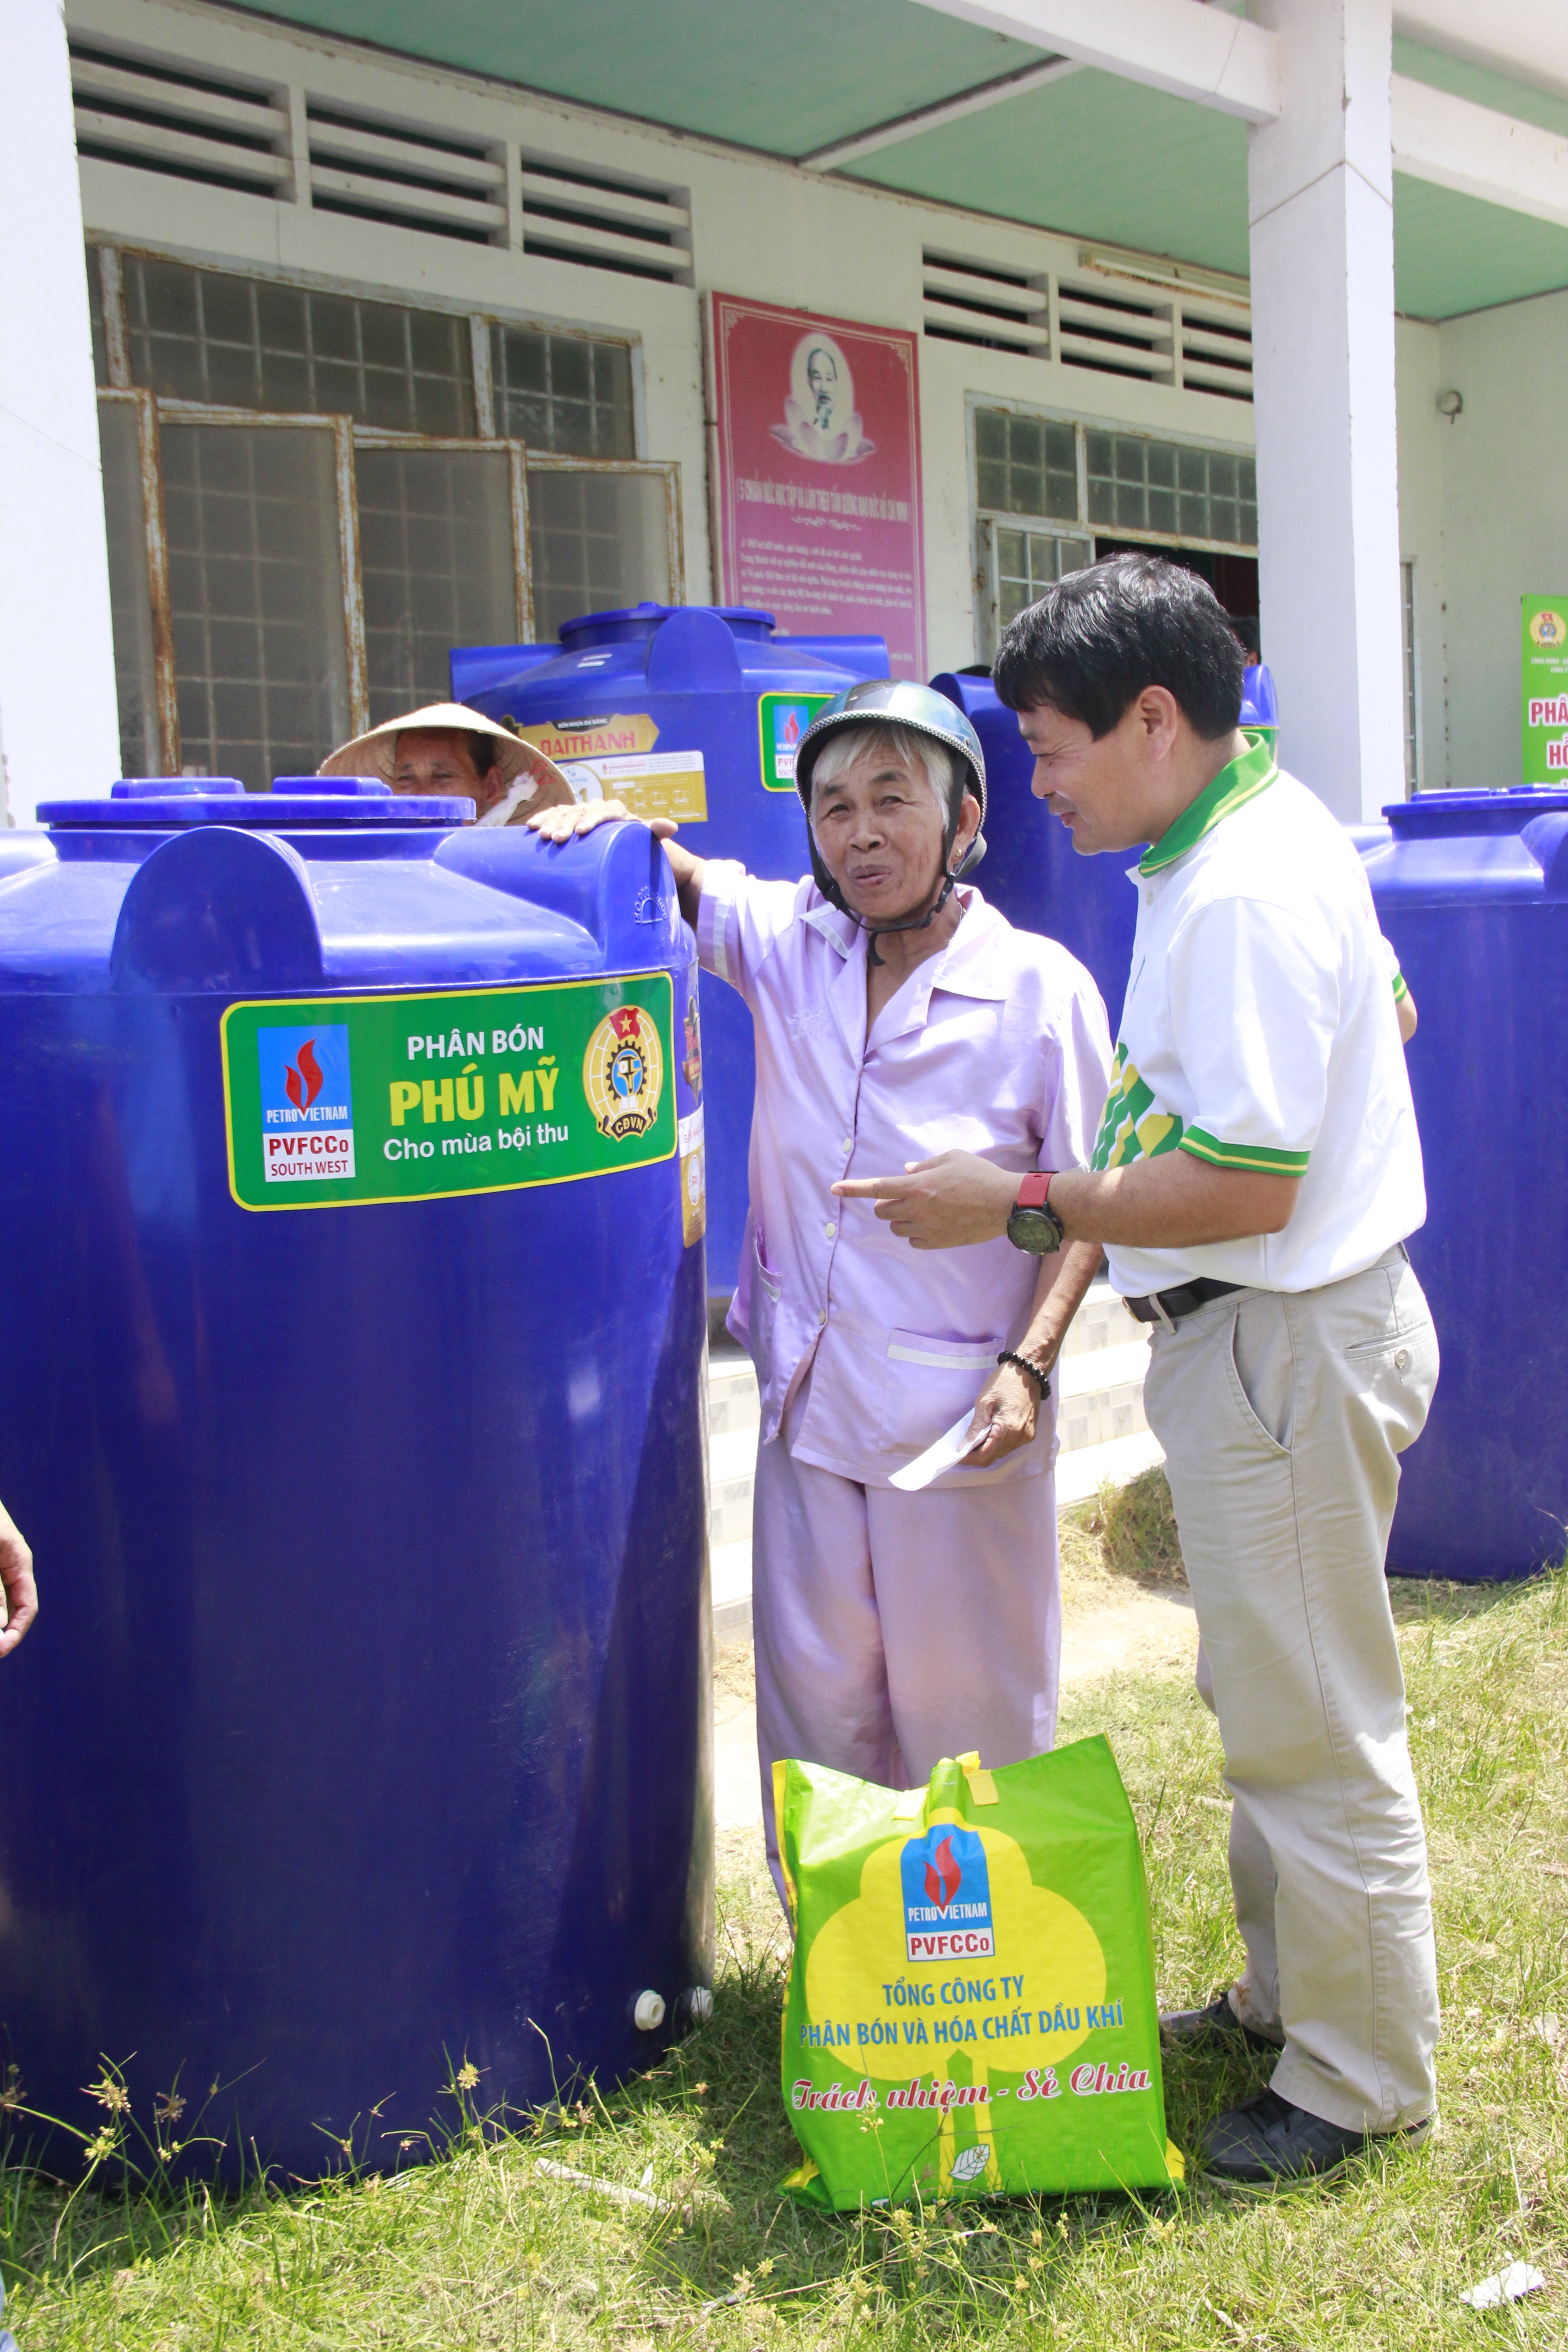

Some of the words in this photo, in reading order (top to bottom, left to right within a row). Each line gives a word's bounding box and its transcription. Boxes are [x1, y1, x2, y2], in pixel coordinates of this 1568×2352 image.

[408, 1028, 485, 1060] PHÂN
[492, 1023, 544, 1054] BÓN
[389, 1062, 485, 1126] PHÚ
[499, 1055, 559, 1116] MỸ
[267, 1106, 348, 1123] PETROVIETNAM
[615, 1117, 643, 1134] CĐVN
[269, 1135, 349, 1156] PVFCCo
[383, 1137, 435, 1161] Cho
[442, 1132, 492, 1156] mùa
[499, 1125, 531, 1151] bội
[537, 1122, 568, 1145] thu
[271, 1162, 313, 1176] SOUTH
[315, 1160, 348, 1174] WEST
[908, 1902, 987, 1921] PETROVIETNAM
[911, 1933, 989, 1955] PVFCCo
[882, 1976, 935, 2006] TỔNG
[941, 1977, 996, 2004] CÔNG
[1000, 1975, 1024, 1999] TY
[800, 2019, 850, 2047] PHÂN
[857, 2018, 897, 2045] BÓN
[903, 2017, 929, 2044] VÀ
[934, 2015, 977, 2043] HÓA
[983, 2006, 1032, 2039] CHẤT
[1039, 2002, 1080, 2034] DẦU
[1086, 1999, 1124, 2029] KHÍ
[792, 2078, 880, 2111] Trách
[886, 2077, 992, 2115] nhiệm
[1016, 2067, 1063, 2102] Sẻ
[1070, 2062, 1152, 2096] Chia
